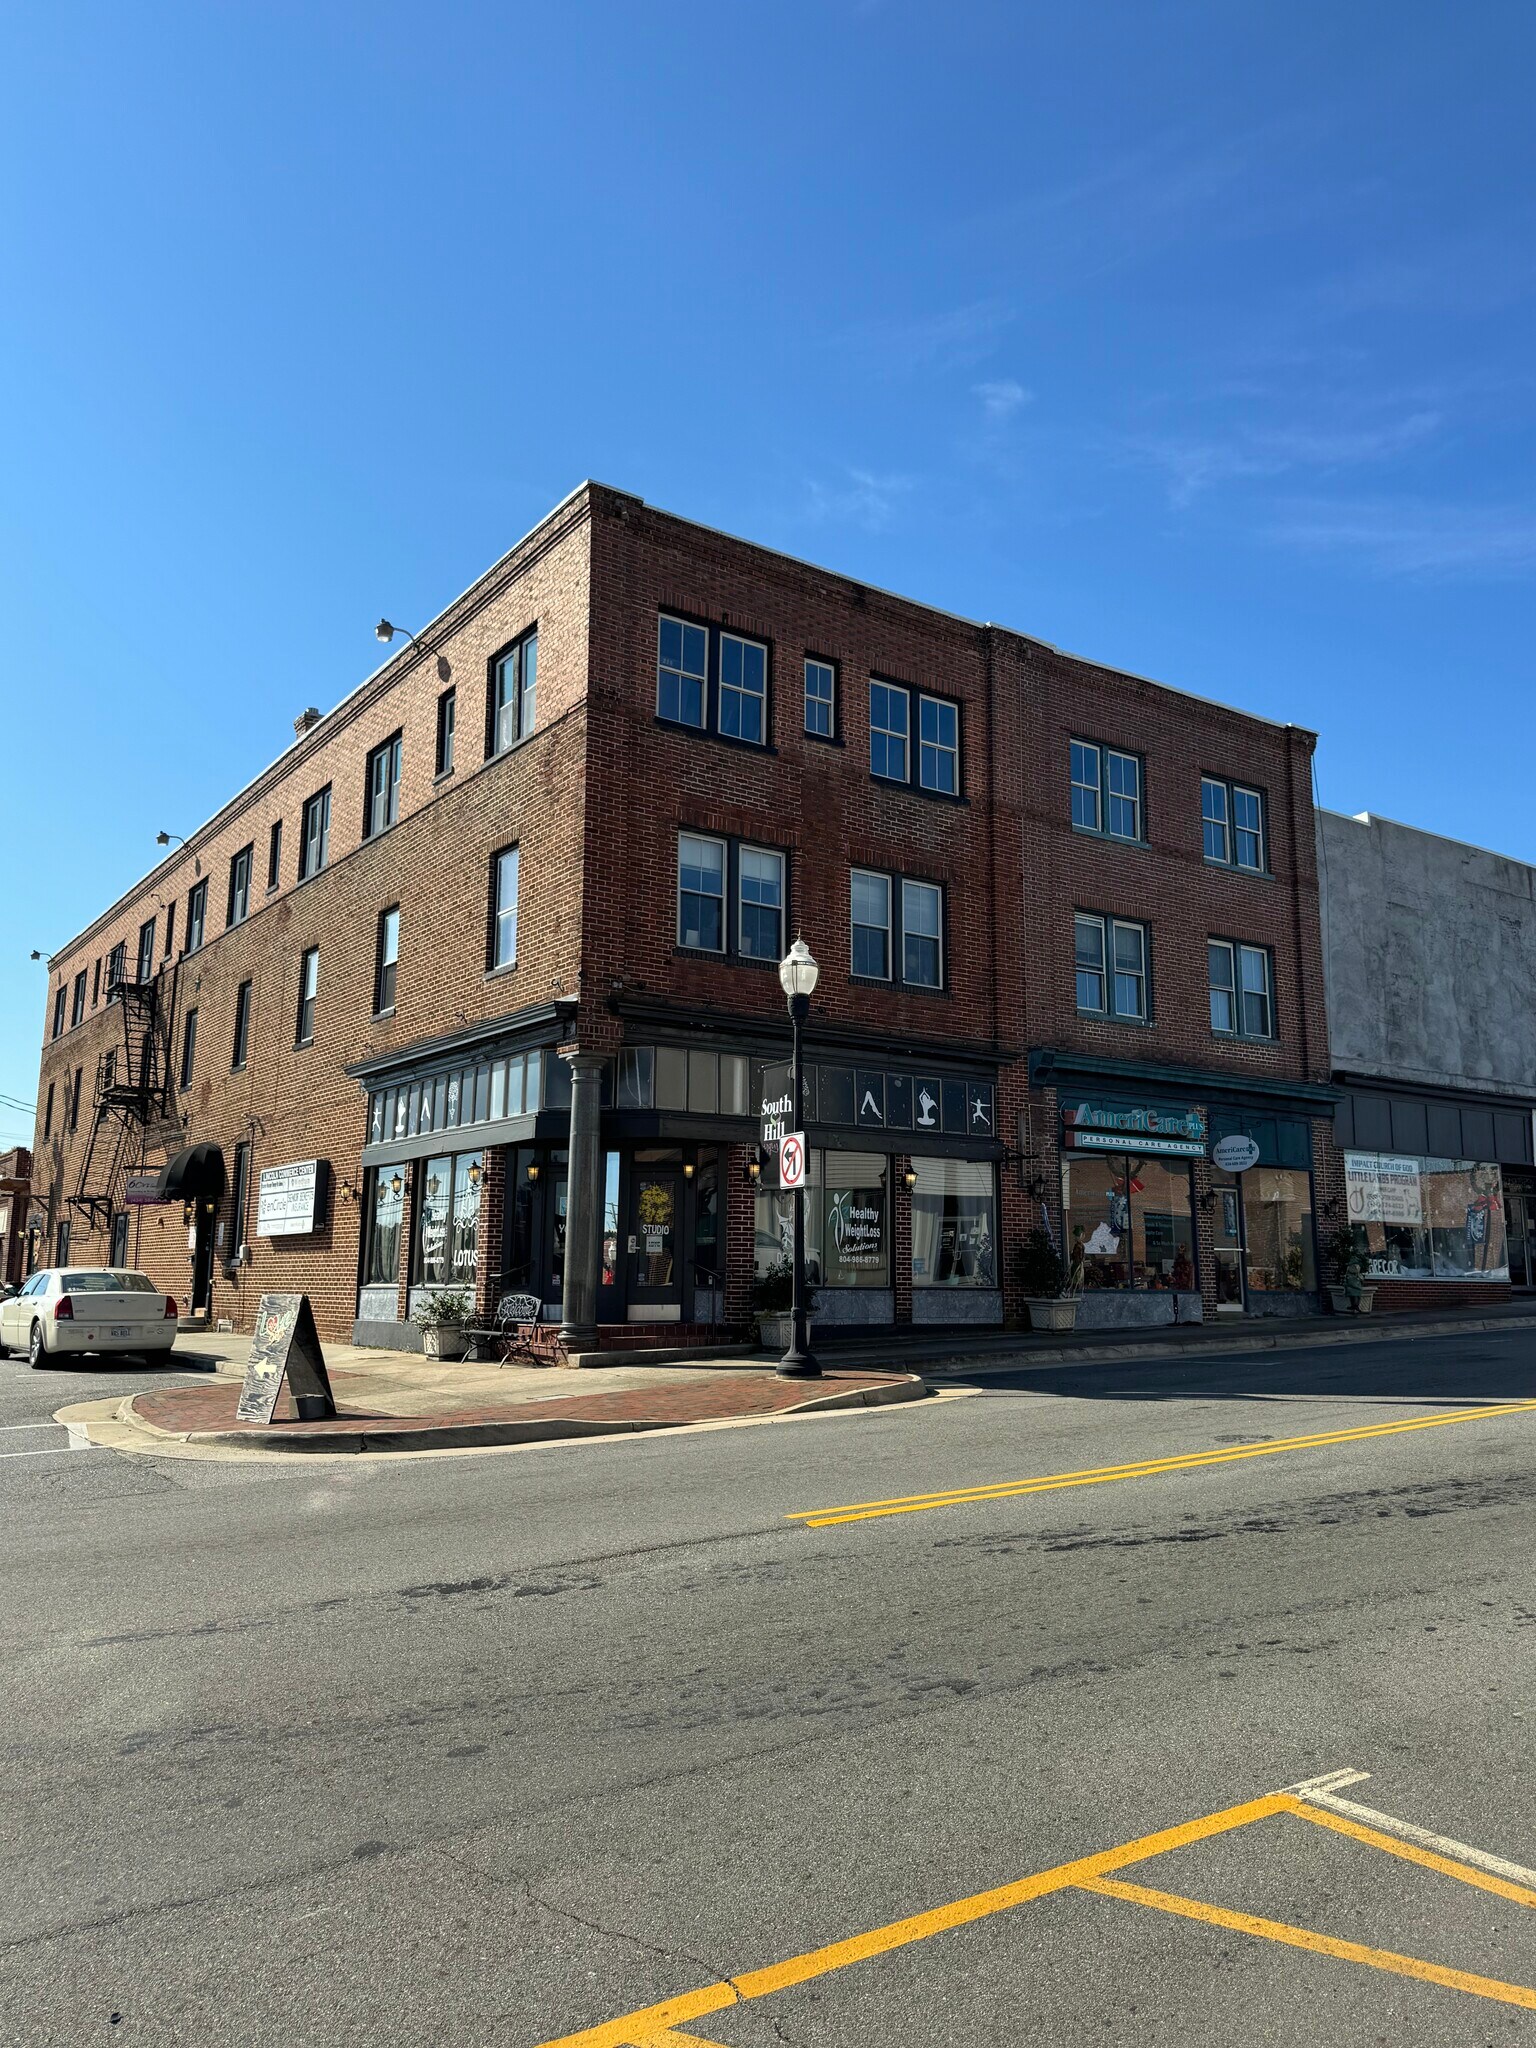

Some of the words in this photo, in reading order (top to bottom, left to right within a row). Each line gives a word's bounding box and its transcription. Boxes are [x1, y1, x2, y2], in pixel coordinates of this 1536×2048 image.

[761, 1094, 792, 1116] South
[1074, 1103, 1189, 1136] AmeriCare
[1188, 1122, 1204, 1131] PLUS
[764, 1121, 785, 1141] Hill
[1083, 1136, 1132, 1145] PERSONAL
[1138, 1140, 1161, 1148] CARE
[1167, 1143, 1202, 1151] AGENCY
[1395, 1163, 1402, 1172] OF
[1348, 1171, 1369, 1182] LITTLE
[849, 1206, 879, 1223] Healthy
[642, 1224, 670, 1235] STUDIO
[845, 1223, 881, 1240] WeightLoss
[842, 1242, 878, 1254] Solutions
[453, 1249, 479, 1267] LOTUS
